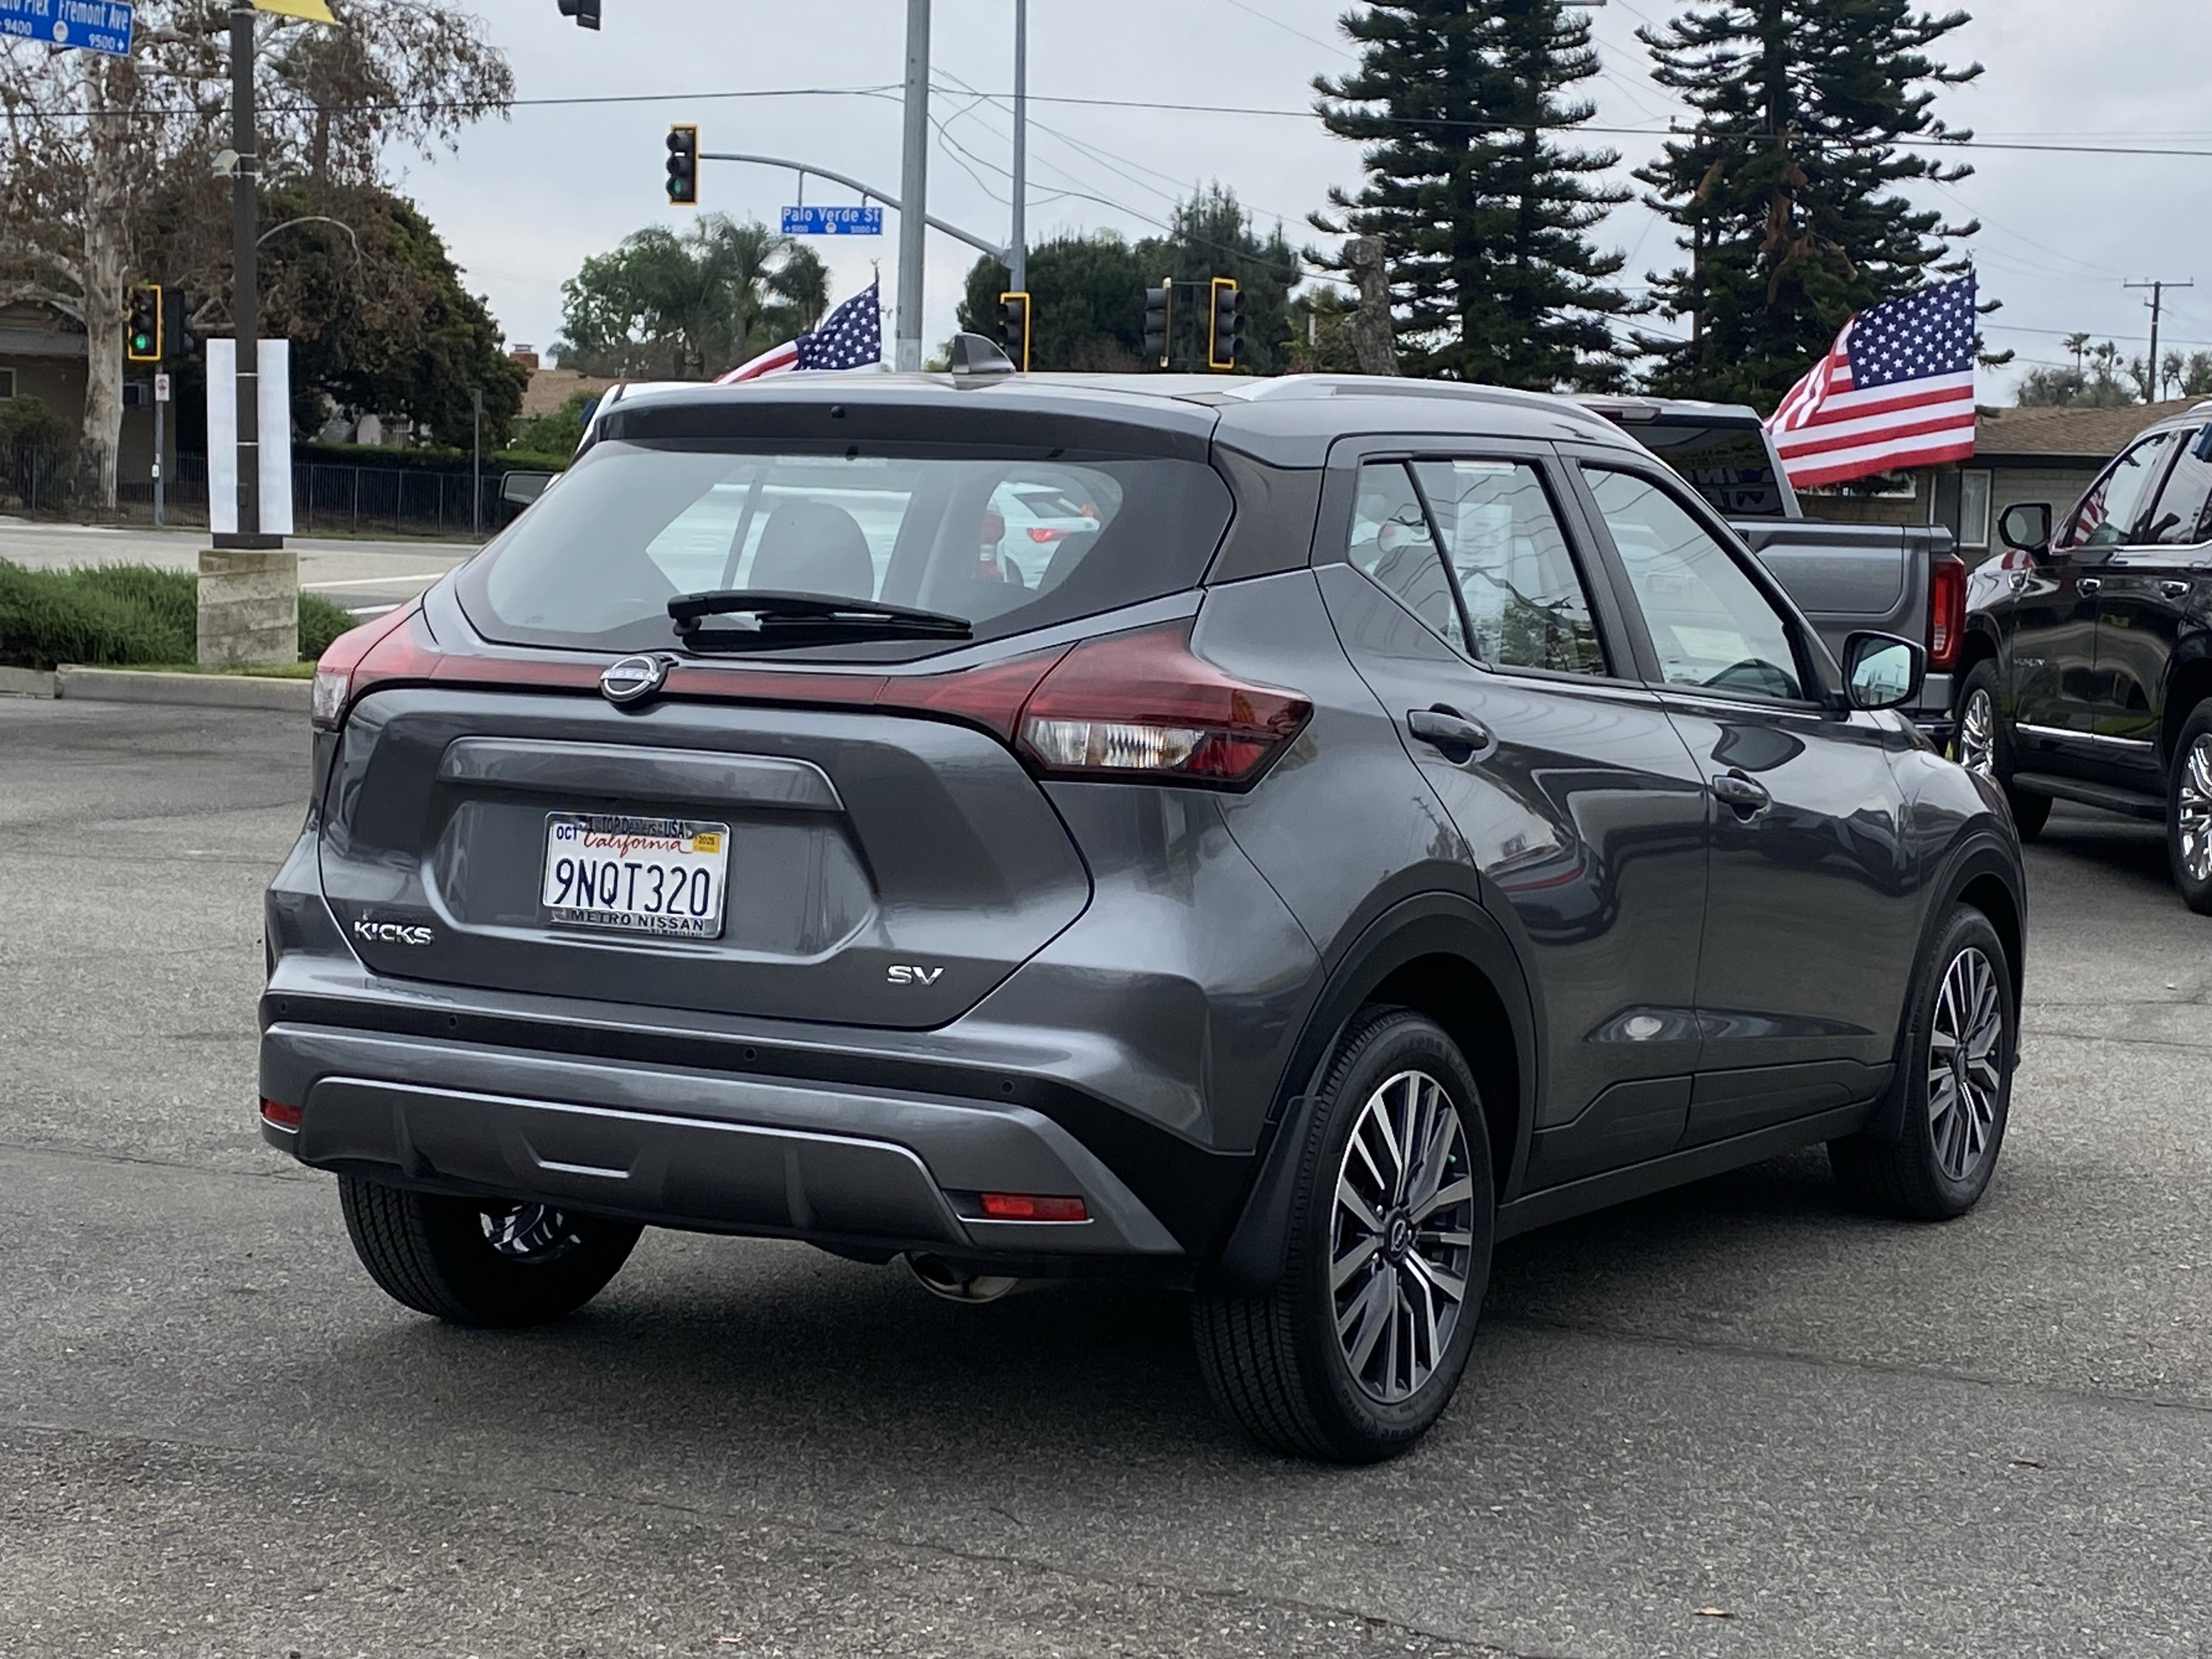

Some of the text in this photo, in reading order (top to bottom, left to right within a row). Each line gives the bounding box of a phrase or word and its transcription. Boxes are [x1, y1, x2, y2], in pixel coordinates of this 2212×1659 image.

[58, 0, 106, 27] Fremont
[108, 4, 128, 31] Ave
[4, 18, 116, 50] 9400 9500
[783, 208, 881, 222] Palo Verde St
[602, 669, 660, 683] NISSAN
[556, 825, 577, 840] OCT
[664, 820, 685, 838] USA
[583, 831, 693, 858] California
[553, 857, 710, 916] 9NQT320
[571, 910, 704, 932] METRO NISSAN
[354, 921, 432, 945] KICKS
[887, 965, 944, 985] SV
